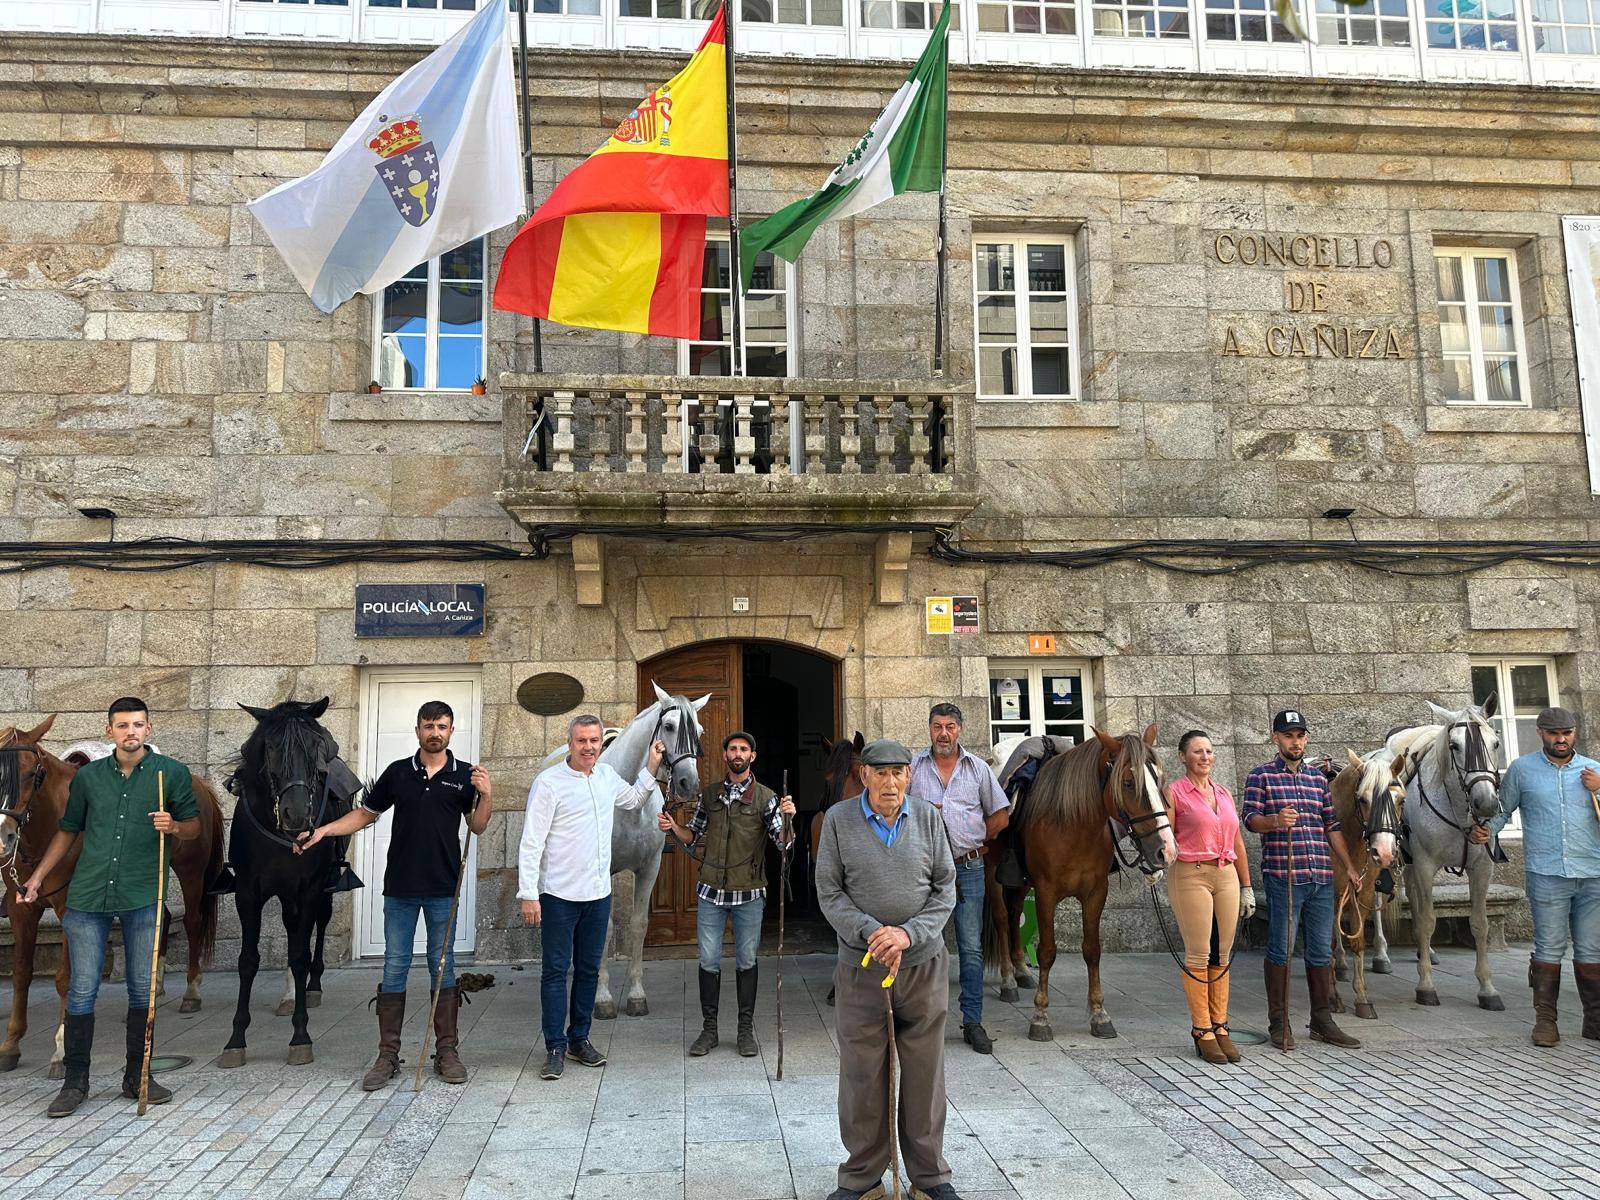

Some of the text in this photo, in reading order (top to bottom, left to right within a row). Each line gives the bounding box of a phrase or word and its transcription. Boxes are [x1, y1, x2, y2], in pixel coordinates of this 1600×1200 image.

[1569, 221, 1591, 232] 1820
[1215, 234, 1394, 268] CONCELLO
[1287, 281, 1328, 312] DE
[1223, 323, 1406, 360] A CAÑIZA
[363, 599, 475, 613] POLICÍA LOCAL
